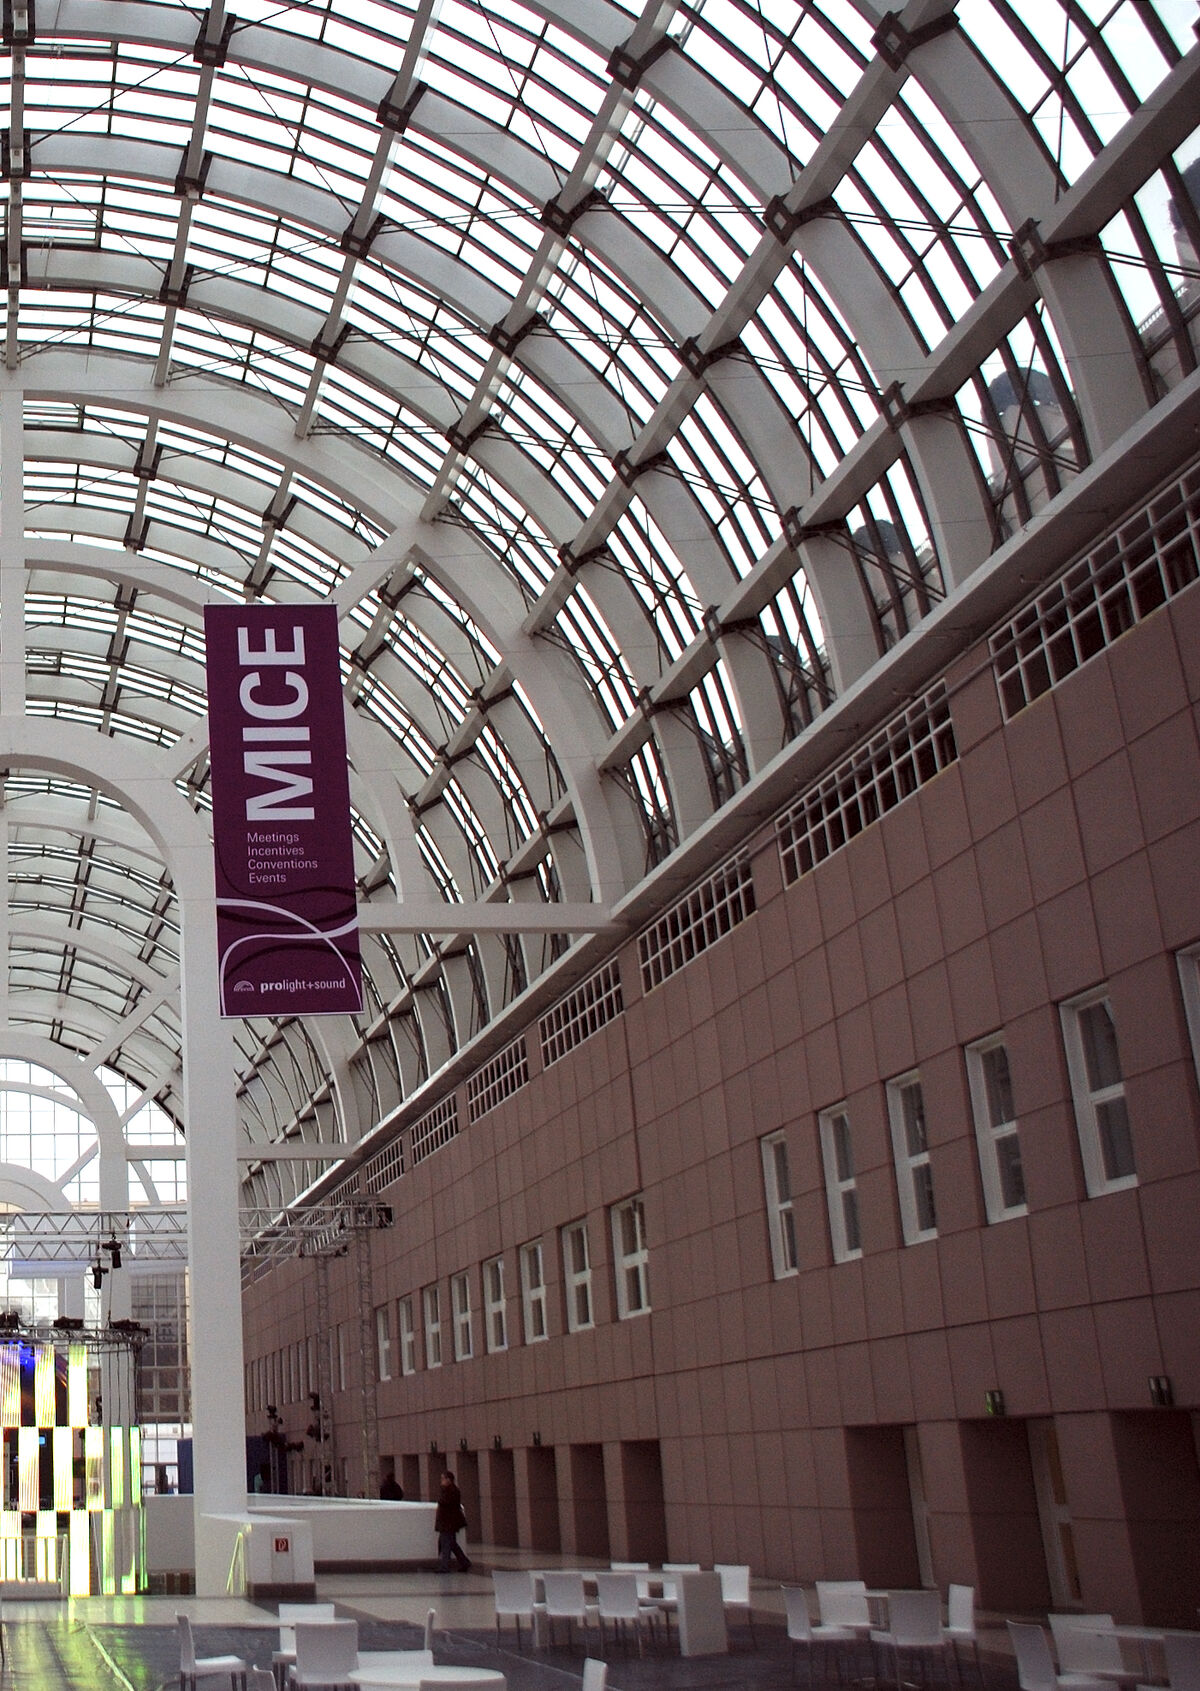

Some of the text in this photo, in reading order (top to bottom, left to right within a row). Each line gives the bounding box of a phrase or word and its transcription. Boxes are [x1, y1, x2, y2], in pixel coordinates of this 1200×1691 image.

[237, 626, 315, 821] MICE
[247, 832, 300, 843] Meetings
[248, 846, 304, 856] Incentives
[248, 859, 318, 870] Conventions
[249, 873, 287, 884] Events
[260, 977, 346, 993] prolight+sound
